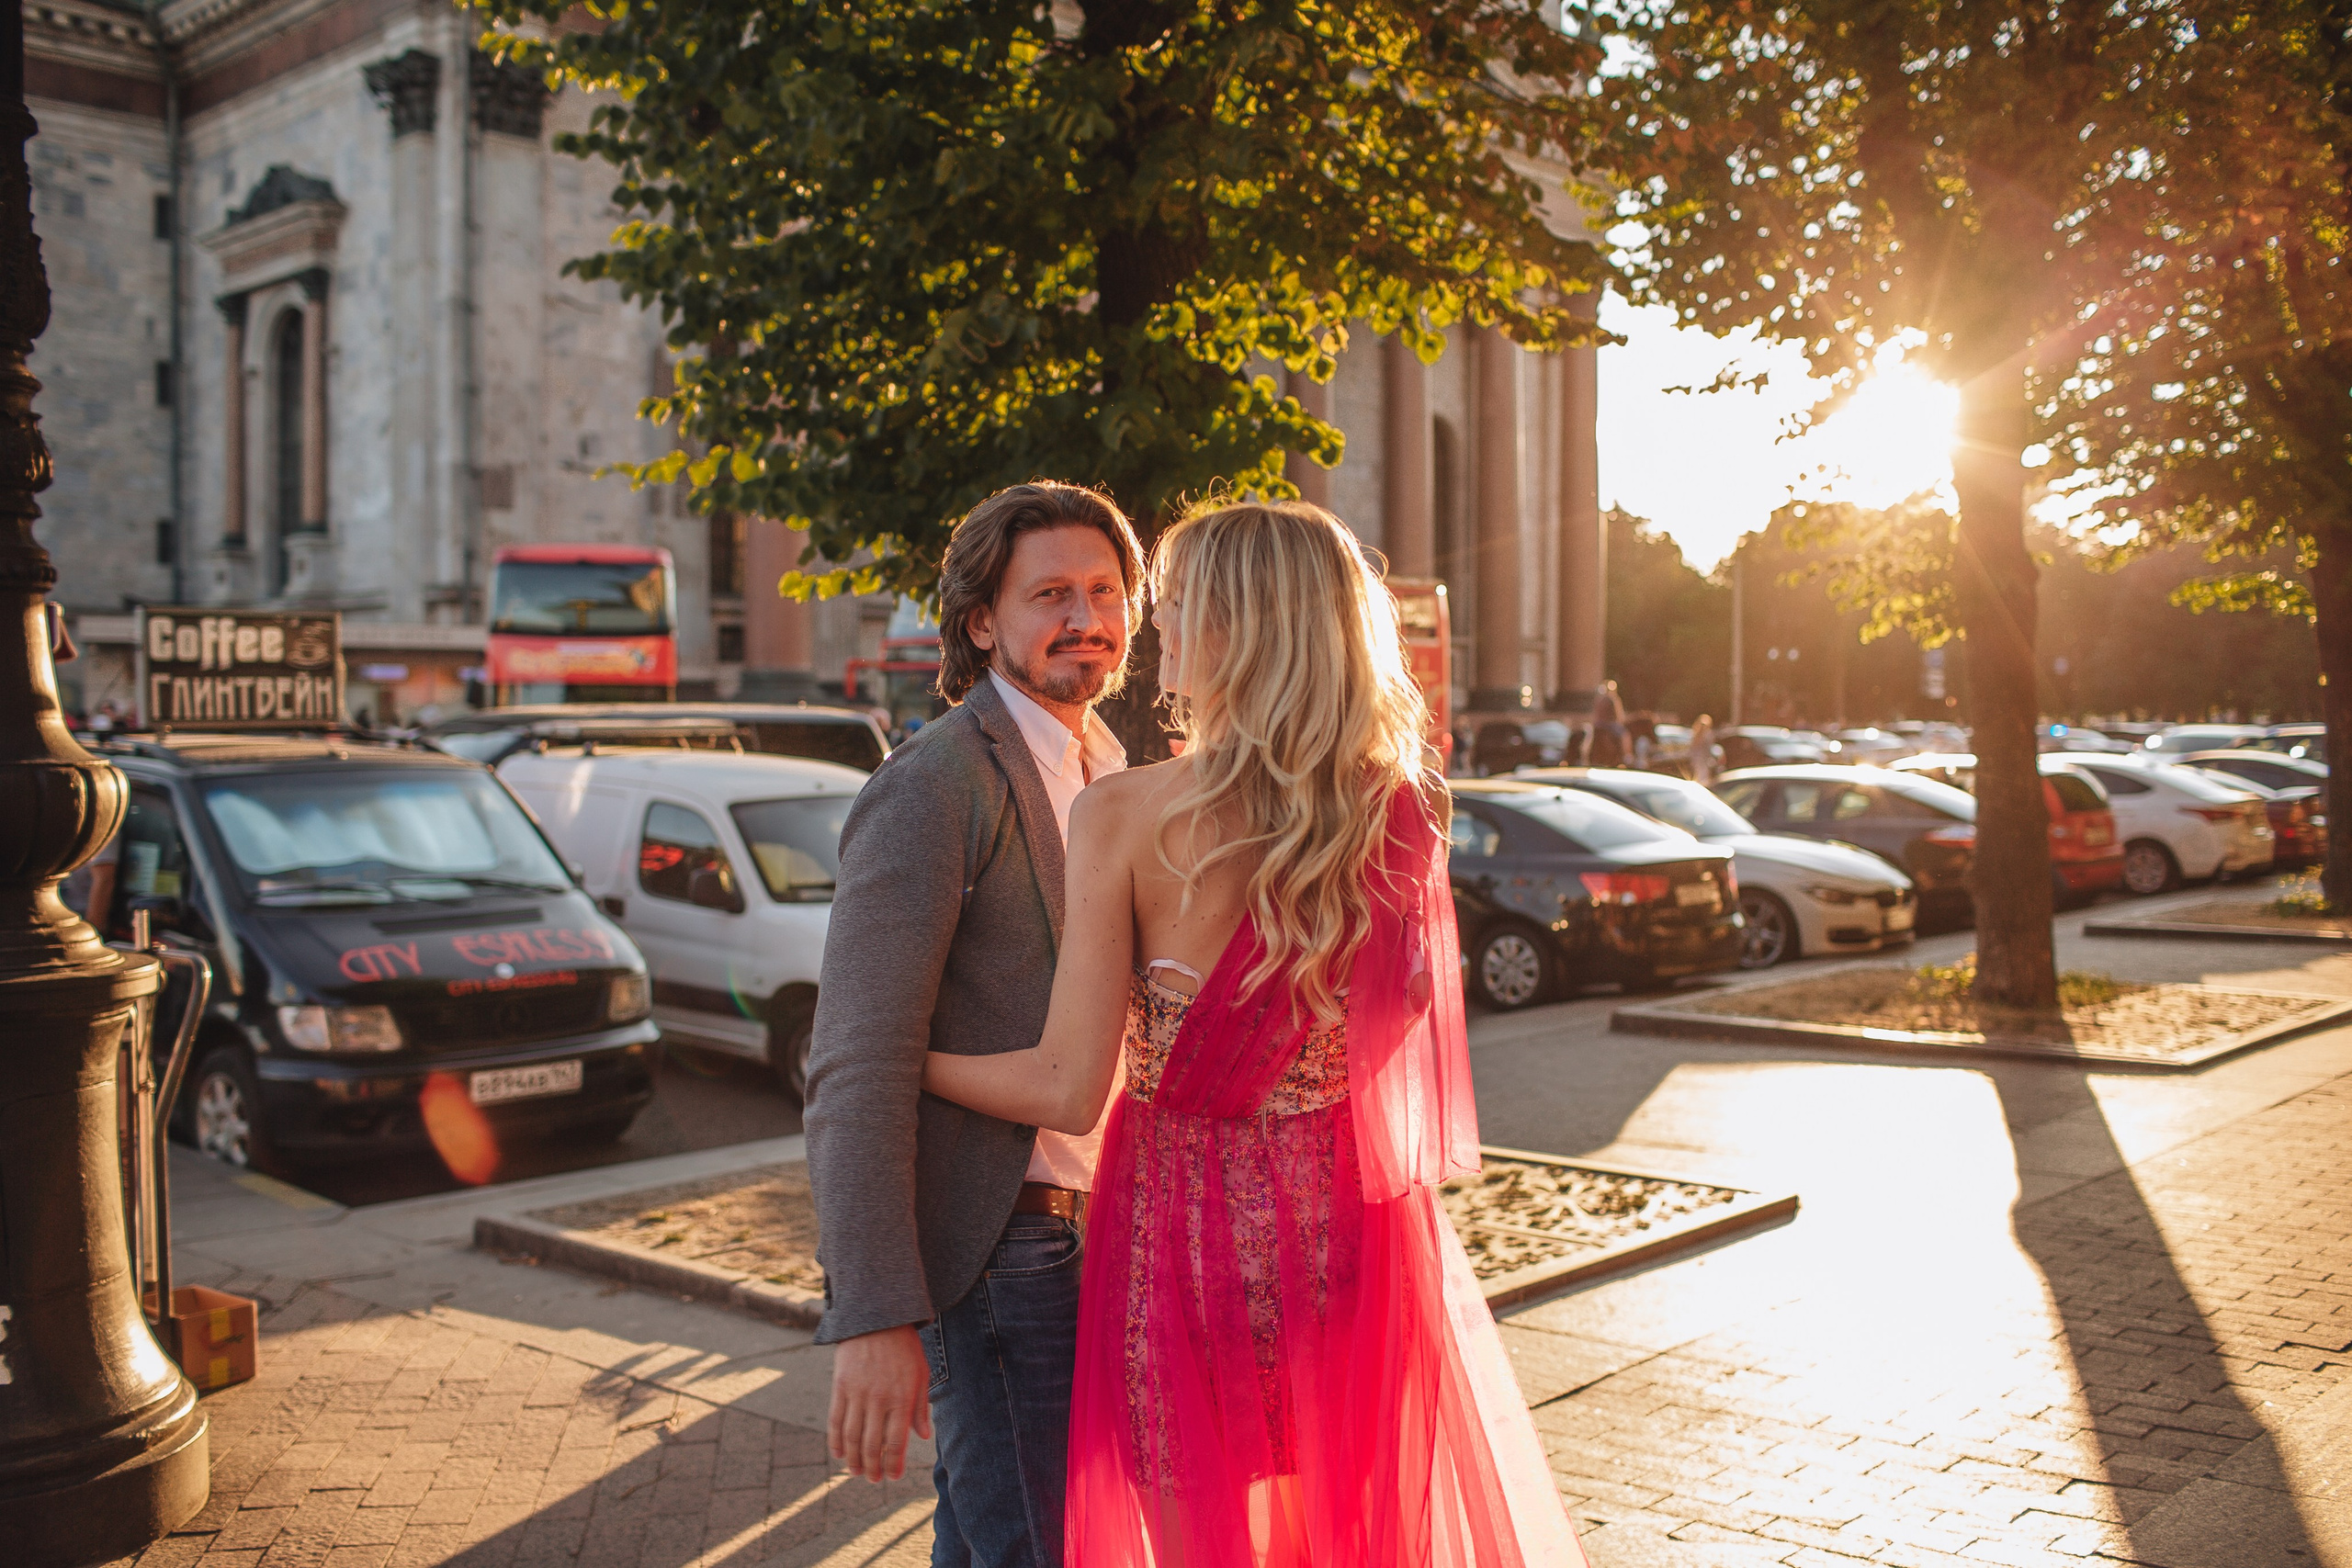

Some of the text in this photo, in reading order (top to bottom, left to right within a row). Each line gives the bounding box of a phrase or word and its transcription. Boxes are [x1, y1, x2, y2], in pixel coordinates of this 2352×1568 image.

[148, 615, 285, 671] Coffee
[150, 671, 334, 721] ГЛИНТВЕЙН
[338, 940, 424, 983] CITY
